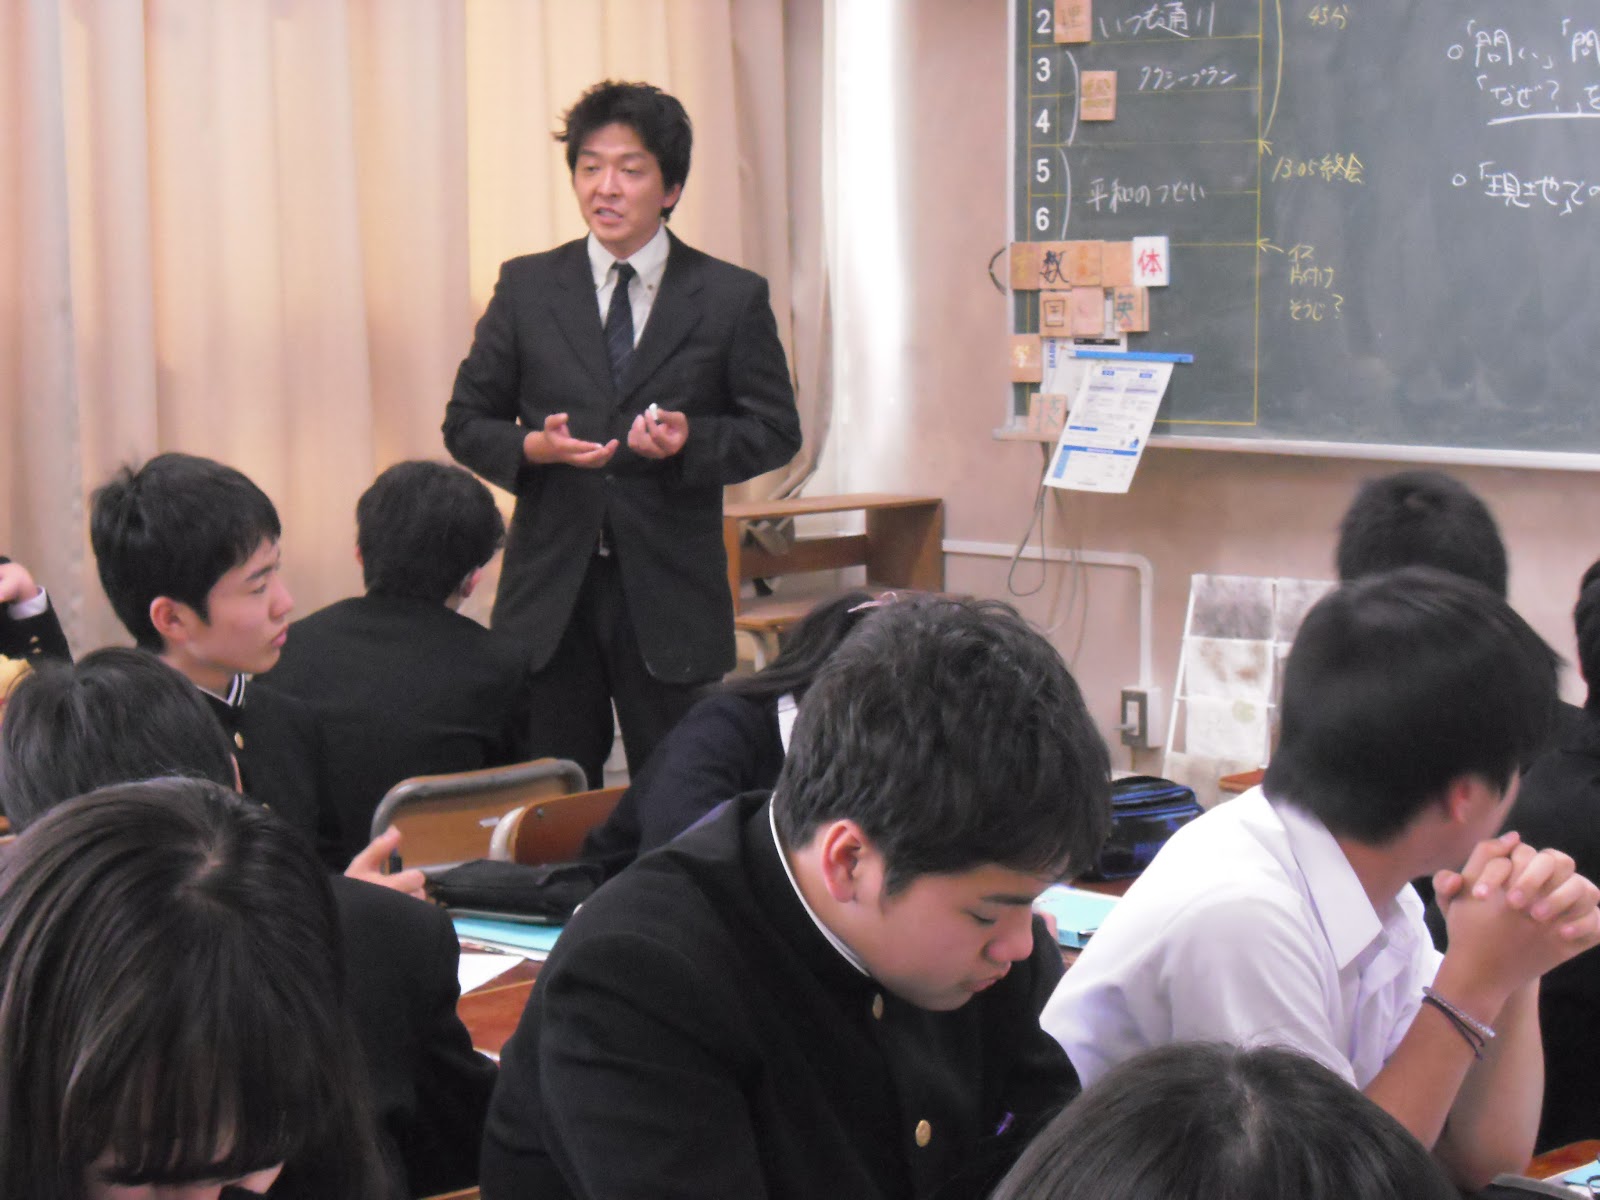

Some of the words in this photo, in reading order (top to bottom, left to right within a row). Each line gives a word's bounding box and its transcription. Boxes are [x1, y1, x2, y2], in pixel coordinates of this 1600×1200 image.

[1036, 9, 1051, 34] 2
[1036, 58, 1051, 82] 3
[1035, 110, 1051, 134] 4
[1036, 158, 1050, 183] 5
[1035, 206, 1050, 231] 6
[1137, 248, 1163, 277] 体
